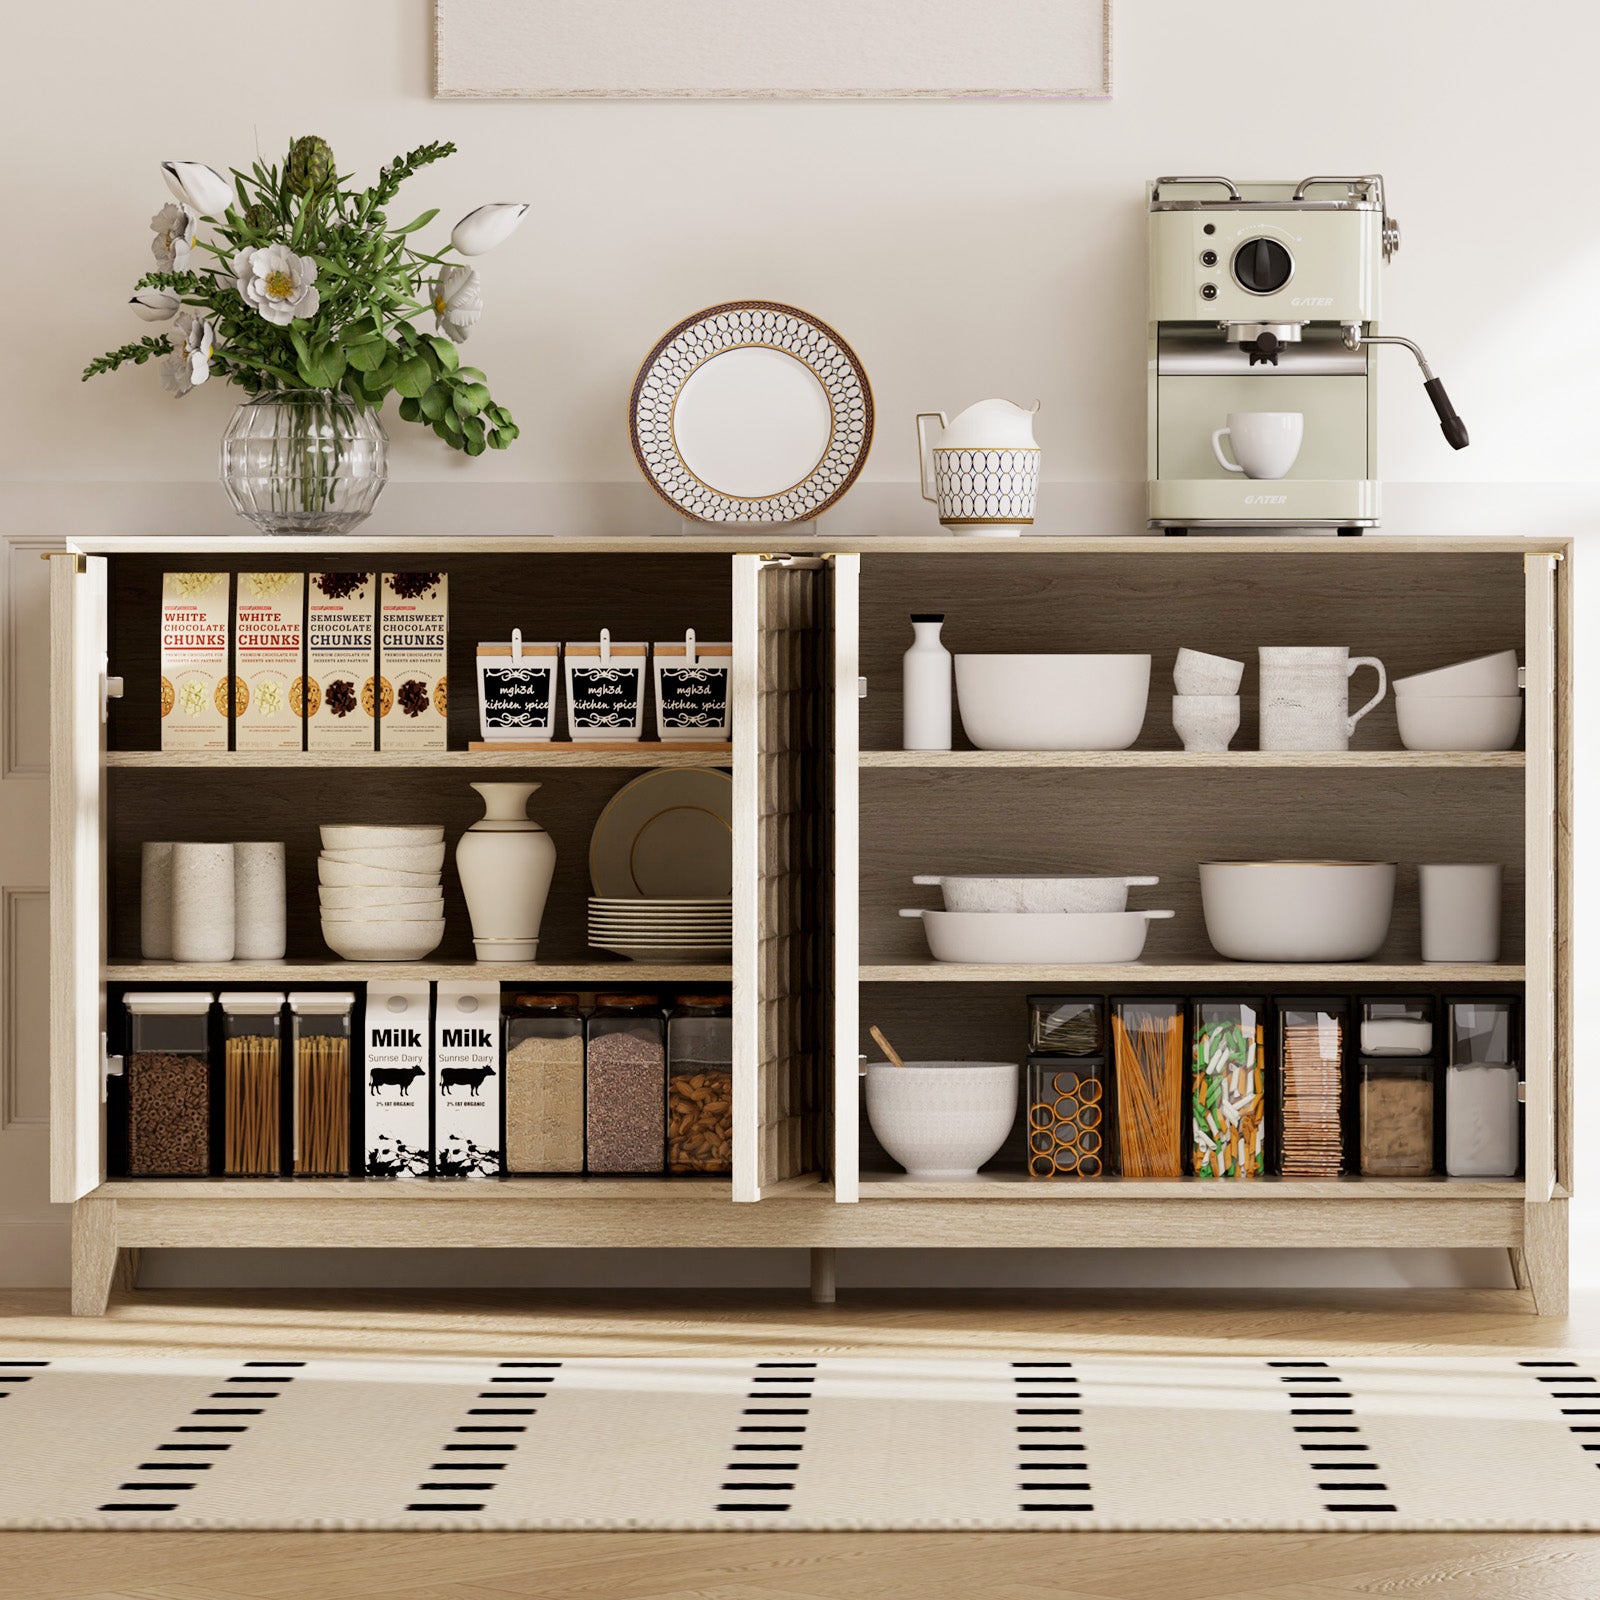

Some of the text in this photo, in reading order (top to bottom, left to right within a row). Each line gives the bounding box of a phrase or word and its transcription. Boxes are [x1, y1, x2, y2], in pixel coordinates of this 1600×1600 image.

[1290, 297, 1334, 306] GATER
[1244, 495, 1287, 505] GATER
[165, 613, 207, 621] WHITE
[239, 613, 281, 621] WHITE
[311, 614, 372, 622] SEMISWEET
[383, 614, 444, 622] SEMISWEET
[164, 634, 225, 645] CHUNKS
[238, 634, 300, 645] CHUNKS
[310, 634, 372, 645] CHUNKS
[383, 634, 444, 645] CHUNKS
[499, 684, 535, 697] mgh3d
[588, 684, 623, 697] mgh3d
[677, 684, 712, 697] mgh3d
[485, 699, 550, 712] kitchen spice
[573, 699, 638, 712] kitchen spice
[662, 699, 727, 712] kitchen spice
[372, 1029, 422, 1047] Milk
[442, 1029, 493, 1047] Milk
[368, 1054, 423, 1063] Sunrise Dairy
[439, 1054, 493, 1063] Sunrise Dairy
